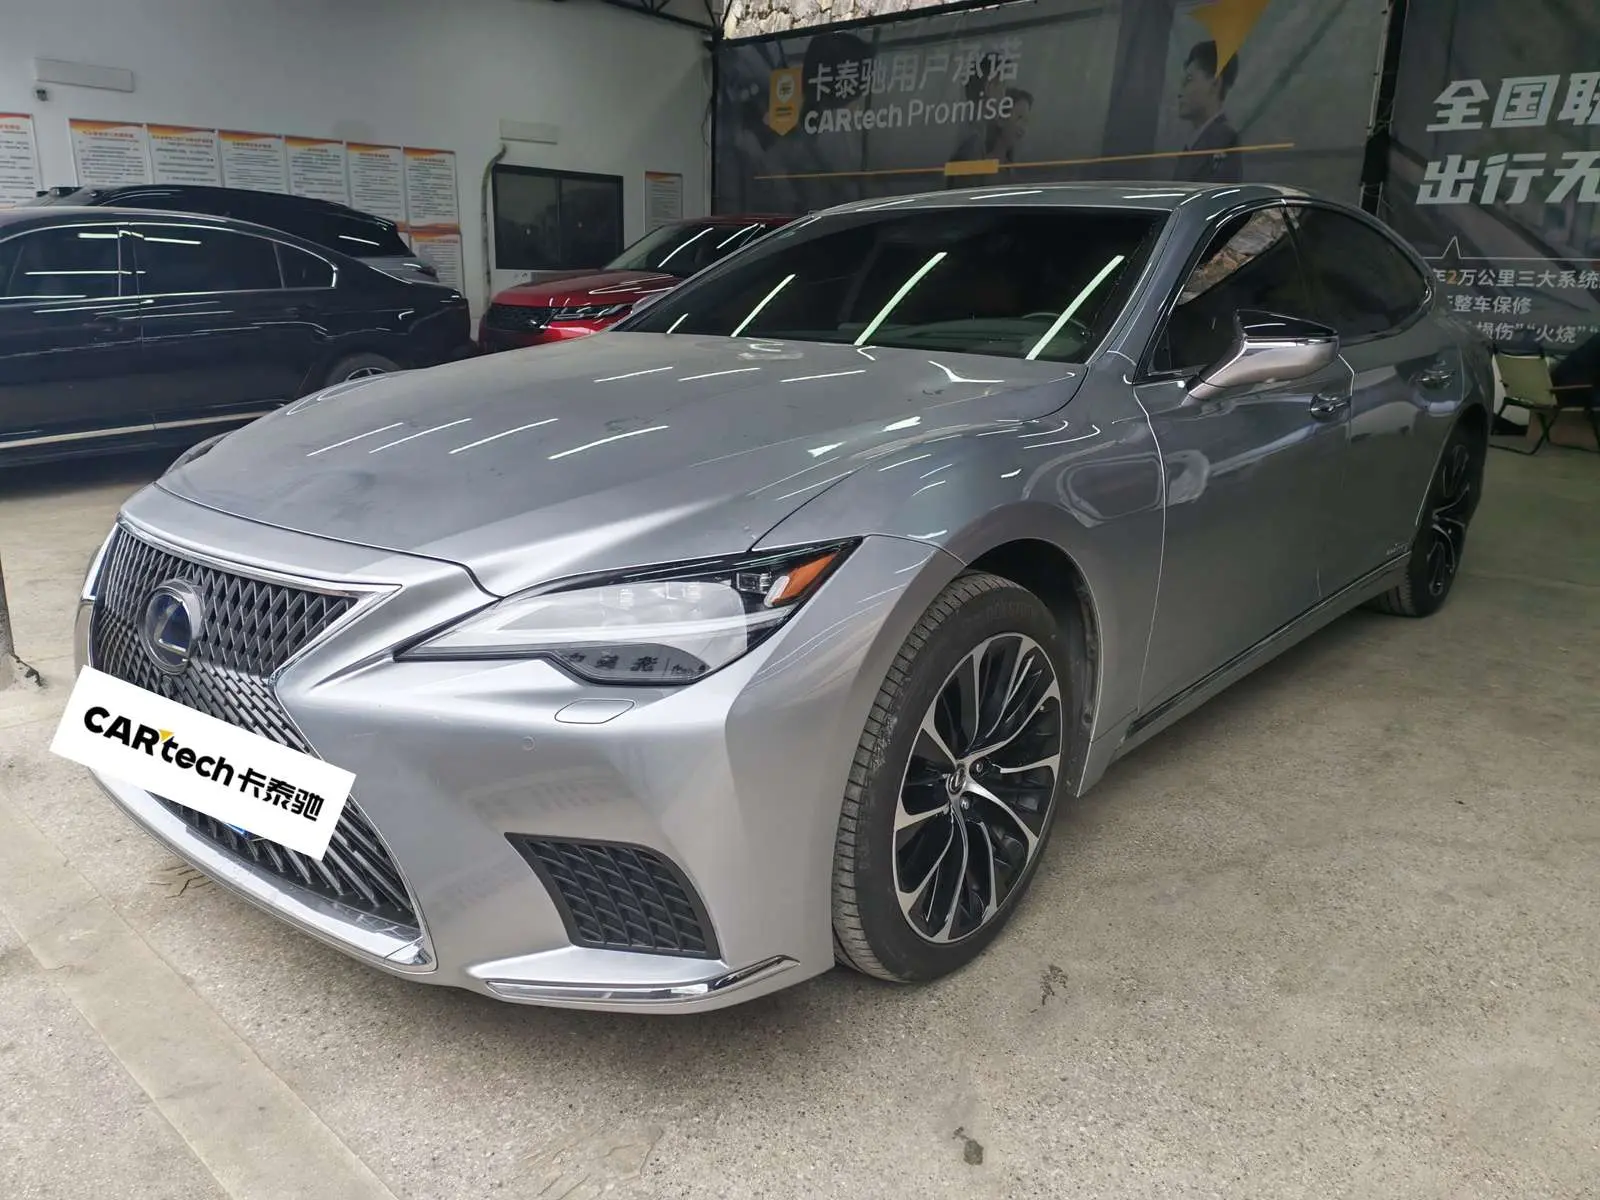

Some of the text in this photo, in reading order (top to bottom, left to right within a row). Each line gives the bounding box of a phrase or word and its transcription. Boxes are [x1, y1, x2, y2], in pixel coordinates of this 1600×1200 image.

[808, 40, 1021, 101] 卡泰驰用户承诺
[804, 92, 1014, 134] CARtech Promise
[1416, 150, 1600, 205] 出行无
[1447, 294, 1532, 315] 整车保修
